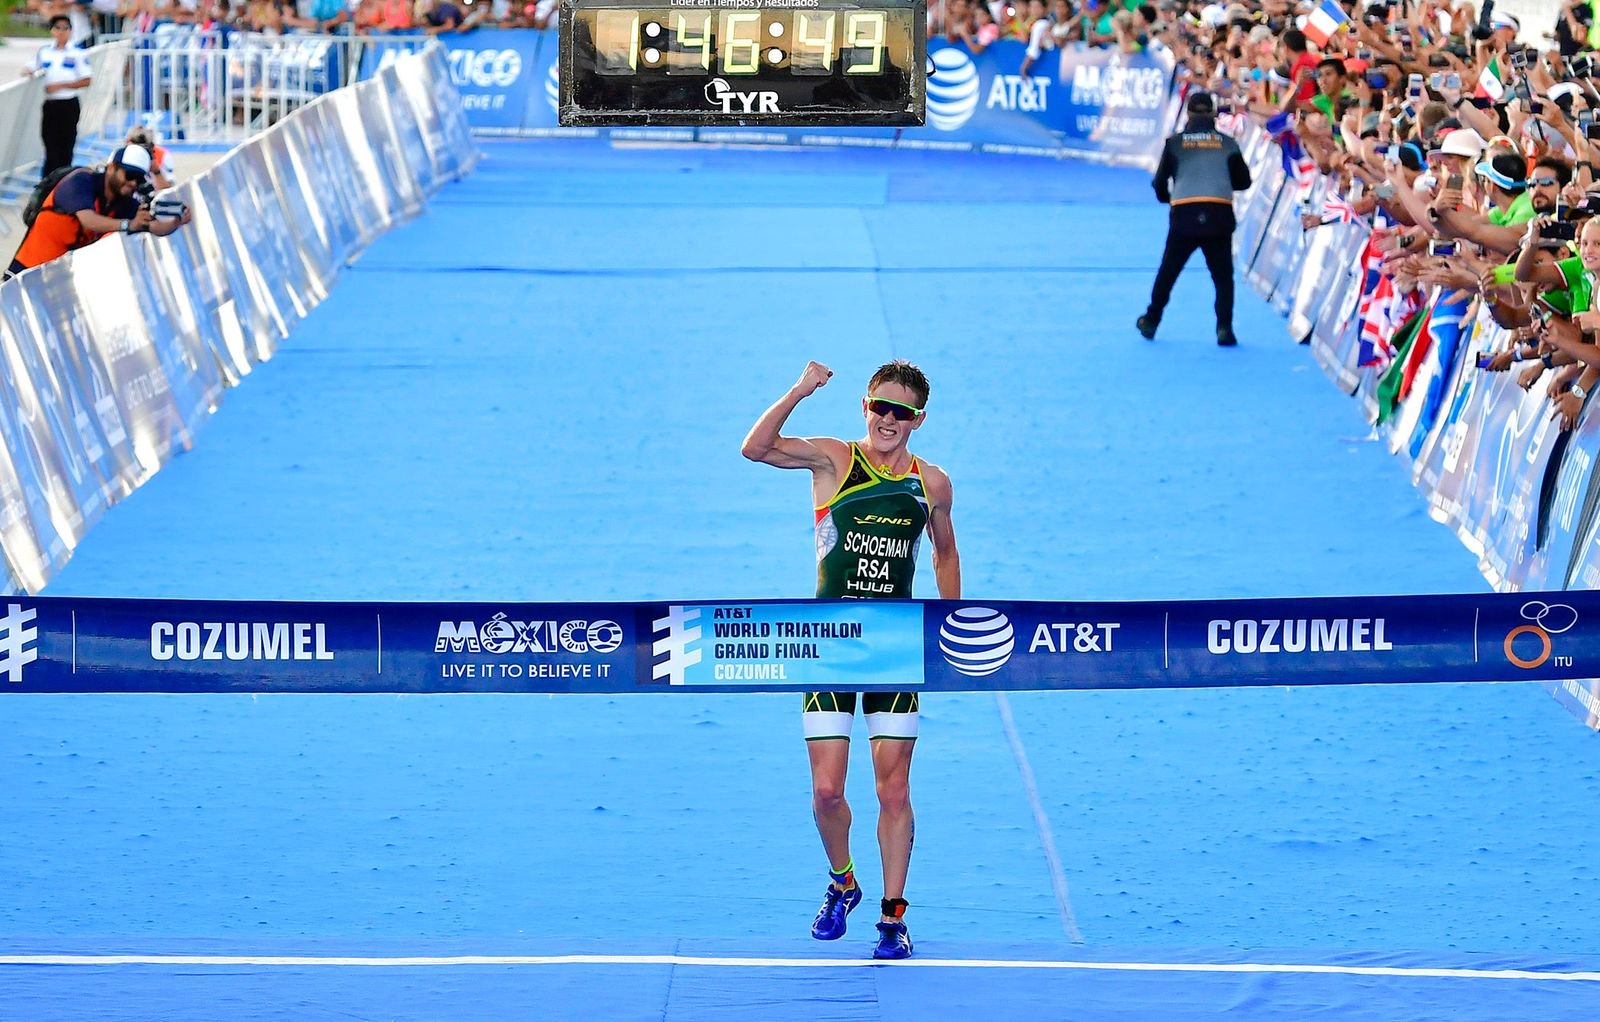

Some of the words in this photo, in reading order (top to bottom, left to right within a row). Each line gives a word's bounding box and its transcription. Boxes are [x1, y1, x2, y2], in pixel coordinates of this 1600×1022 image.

[716, 91, 780, 113] TYR
[986, 73, 1052, 113] AT&T
[864, 514, 913, 526] FINIS
[844, 530, 910, 559] SCHOEMAN
[857, 557, 889, 580] RSA
[847, 579, 895, 594] HUUB
[713, 607, 753, 620] AT&T
[434, 611, 623, 654] MÉXICO
[714, 622, 770, 638] WORLD
[775, 622, 862, 638] TRIATHLON
[1028, 622, 1121, 654] AT&T
[1207, 617, 1393, 655] COZUMEL
[150, 621, 335, 661] COZUMEL
[714, 643, 769, 659] GRAND
[775, 643, 820, 659] FINAL
[441, 664, 475, 678] LIVE
[481, 664, 495, 678] IT
[499, 664, 523, 678] TO
[529, 664, 591, 678] BELIEVE
[598, 664, 611, 678] IT
[1554, 655, 1573, 668] ITU
[714, 663, 787, 681] COZUMEL
